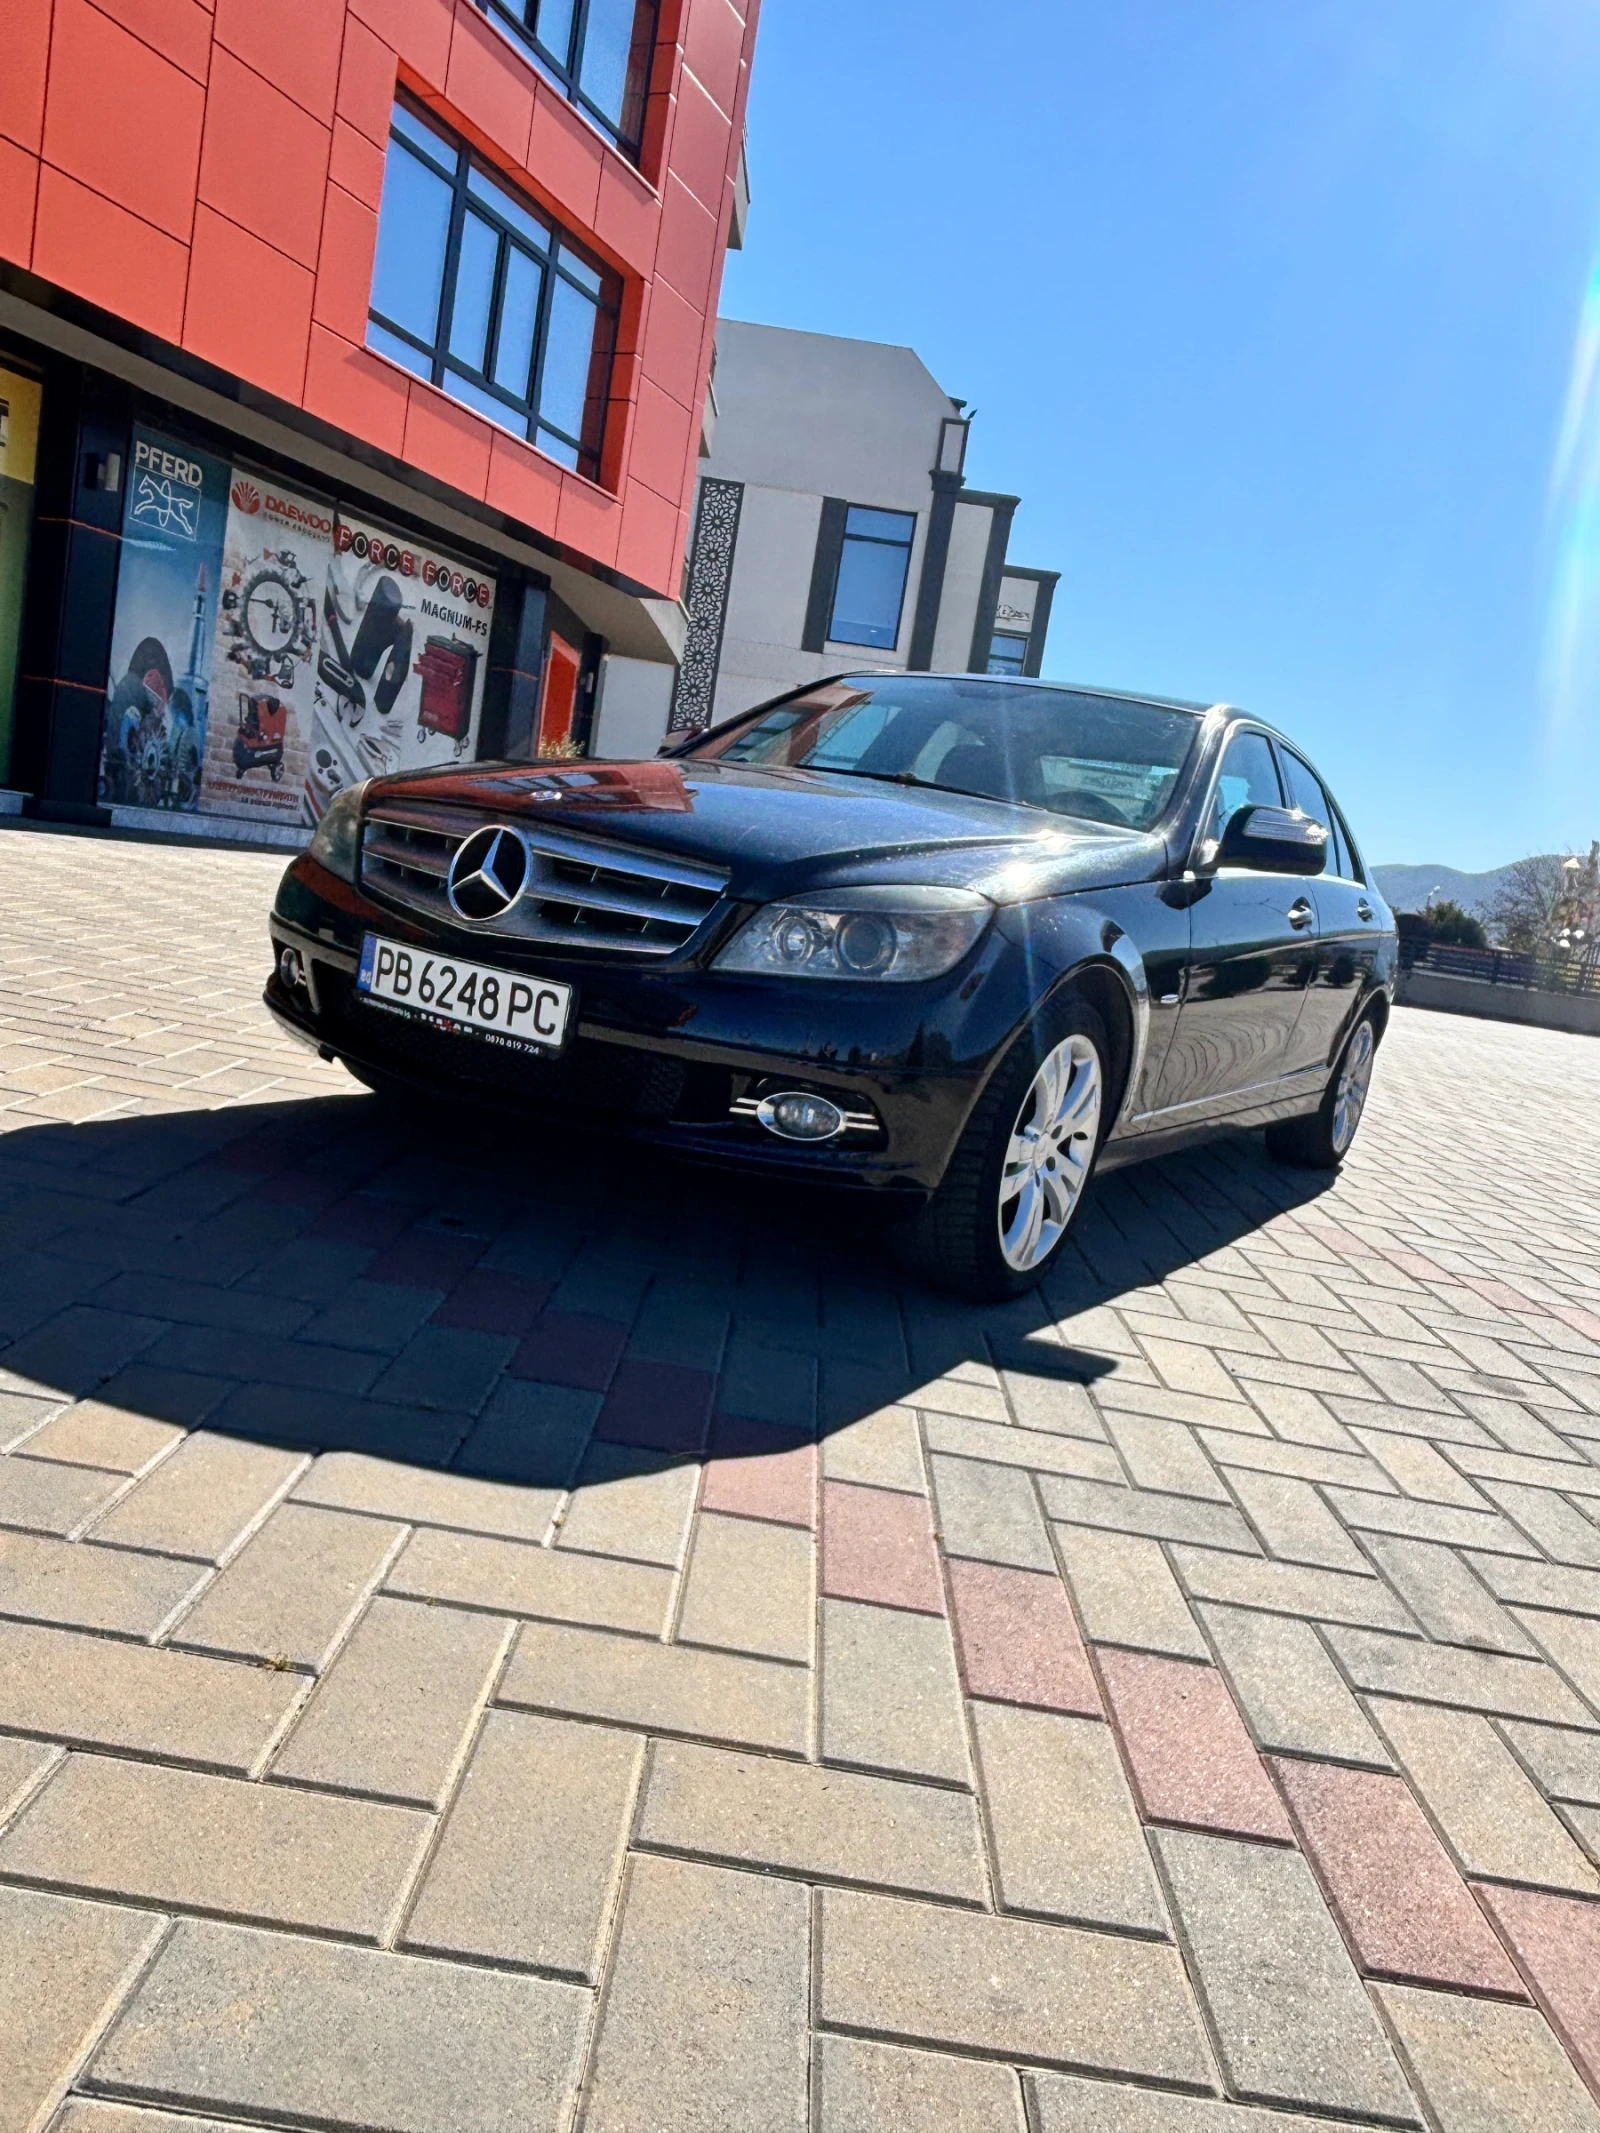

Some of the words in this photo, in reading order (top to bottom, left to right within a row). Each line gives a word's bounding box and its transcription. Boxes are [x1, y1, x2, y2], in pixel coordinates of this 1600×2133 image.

[135, 441, 203, 487] PFERD
[264, 495, 331, 534] DAEWOO
[336, 526, 414, 576] FORCE
[422, 560, 489, 608] FORCE
[420, 598, 488, 637] MAGNUM-FS
[375, 946, 413, 996] PB
[418, 960, 501, 1022] 6248
[506, 981, 560, 1036] PC
